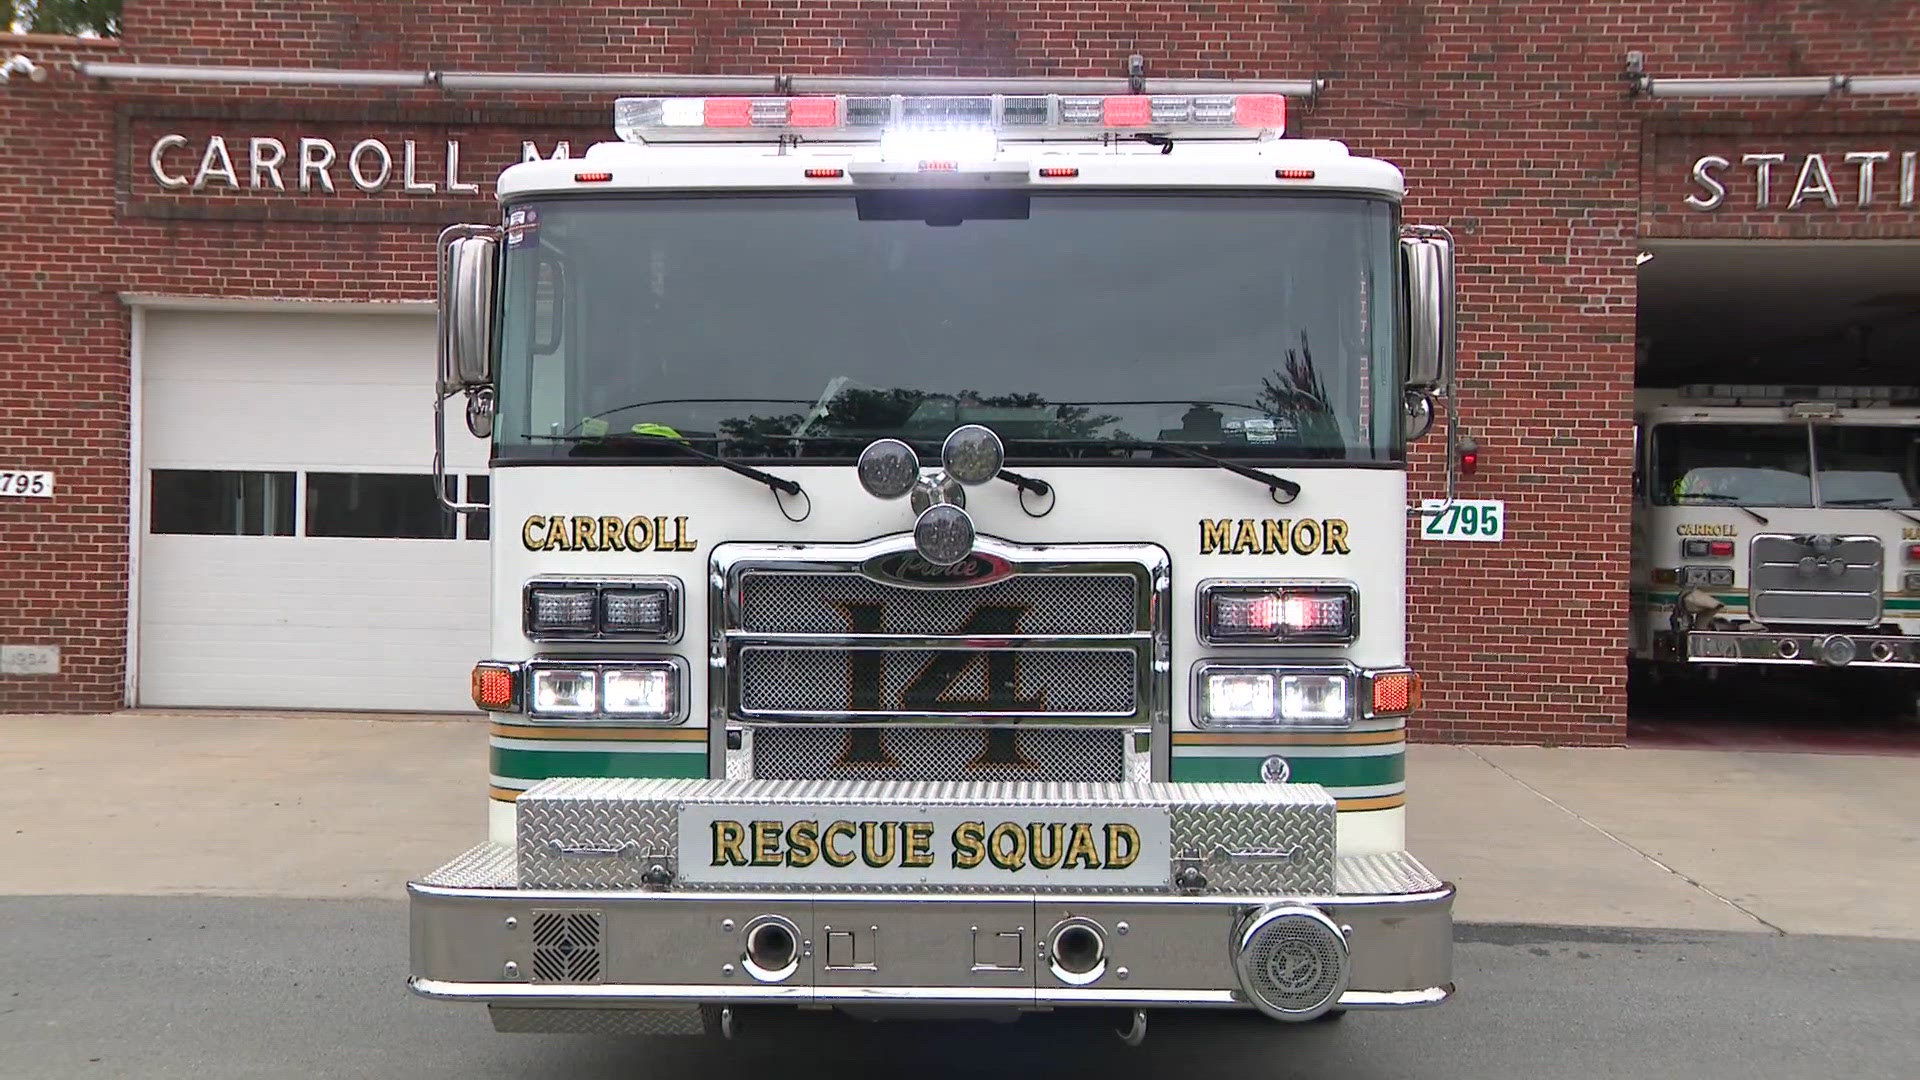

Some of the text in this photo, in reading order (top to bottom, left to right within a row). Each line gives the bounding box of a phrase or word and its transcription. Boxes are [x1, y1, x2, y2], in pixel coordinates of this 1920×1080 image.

[149, 134, 479, 194] CARROLL
[1684, 151, 1916, 211] STATI
[2, 473, 44, 494] 795
[522, 514, 1351, 556] CARROLL MANOR
[1426, 504, 1498, 536] 2795
[1676, 523, 1738, 537] CARROLL
[829, 599, 1046, 770] 14
[710, 819, 1142, 873] RESCUE SQUAD
